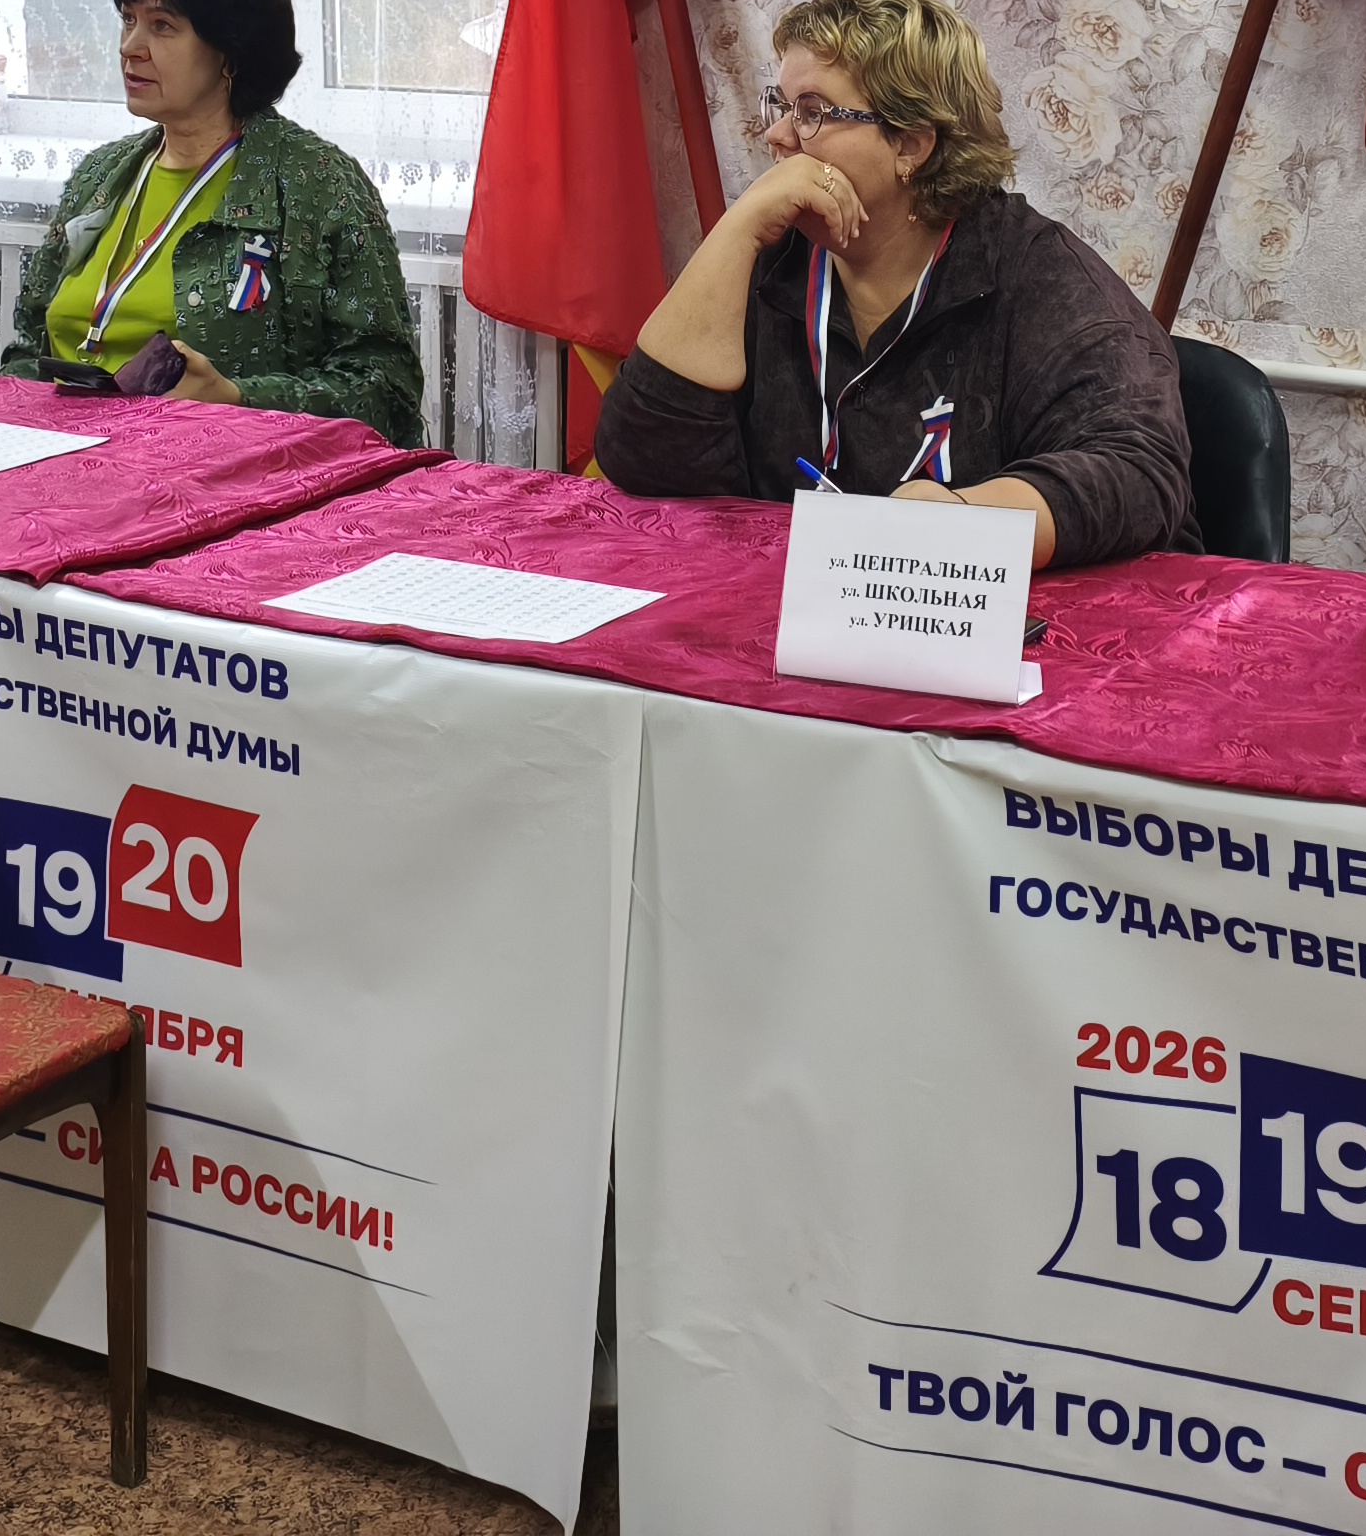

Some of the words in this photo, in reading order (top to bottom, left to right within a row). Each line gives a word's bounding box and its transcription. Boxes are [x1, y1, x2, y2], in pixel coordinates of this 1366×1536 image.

[829, 556, 848, 569] ул.
[852, 553, 1007, 584] ЦЕНТРАЛЬНАЯ
[841, 586, 860, 599] ул.
[865, 583, 987, 610] ШКОЛЬНАЯ
[35, 612, 289, 701] ДЕПУТАТОВ
[849, 615, 868, 628] ул.
[873, 612, 973, 637] УРИЦКАЯ
[186, 721, 300, 776] ДУМЫ
[1002, 786, 1270, 878] ВЫБОРЫ
[5, 843, 96, 936] 19
[121, 822, 229, 922] 20
[1076, 1022, 1228, 1083] 2026
[192, 1154, 394, 1252] РОССИИ!
[1096, 1148, 1228, 1262] 18
[867, 1363, 1035, 1432] ТВОЙ
[1055, 1391, 1266, 1474] ГОЛОС
